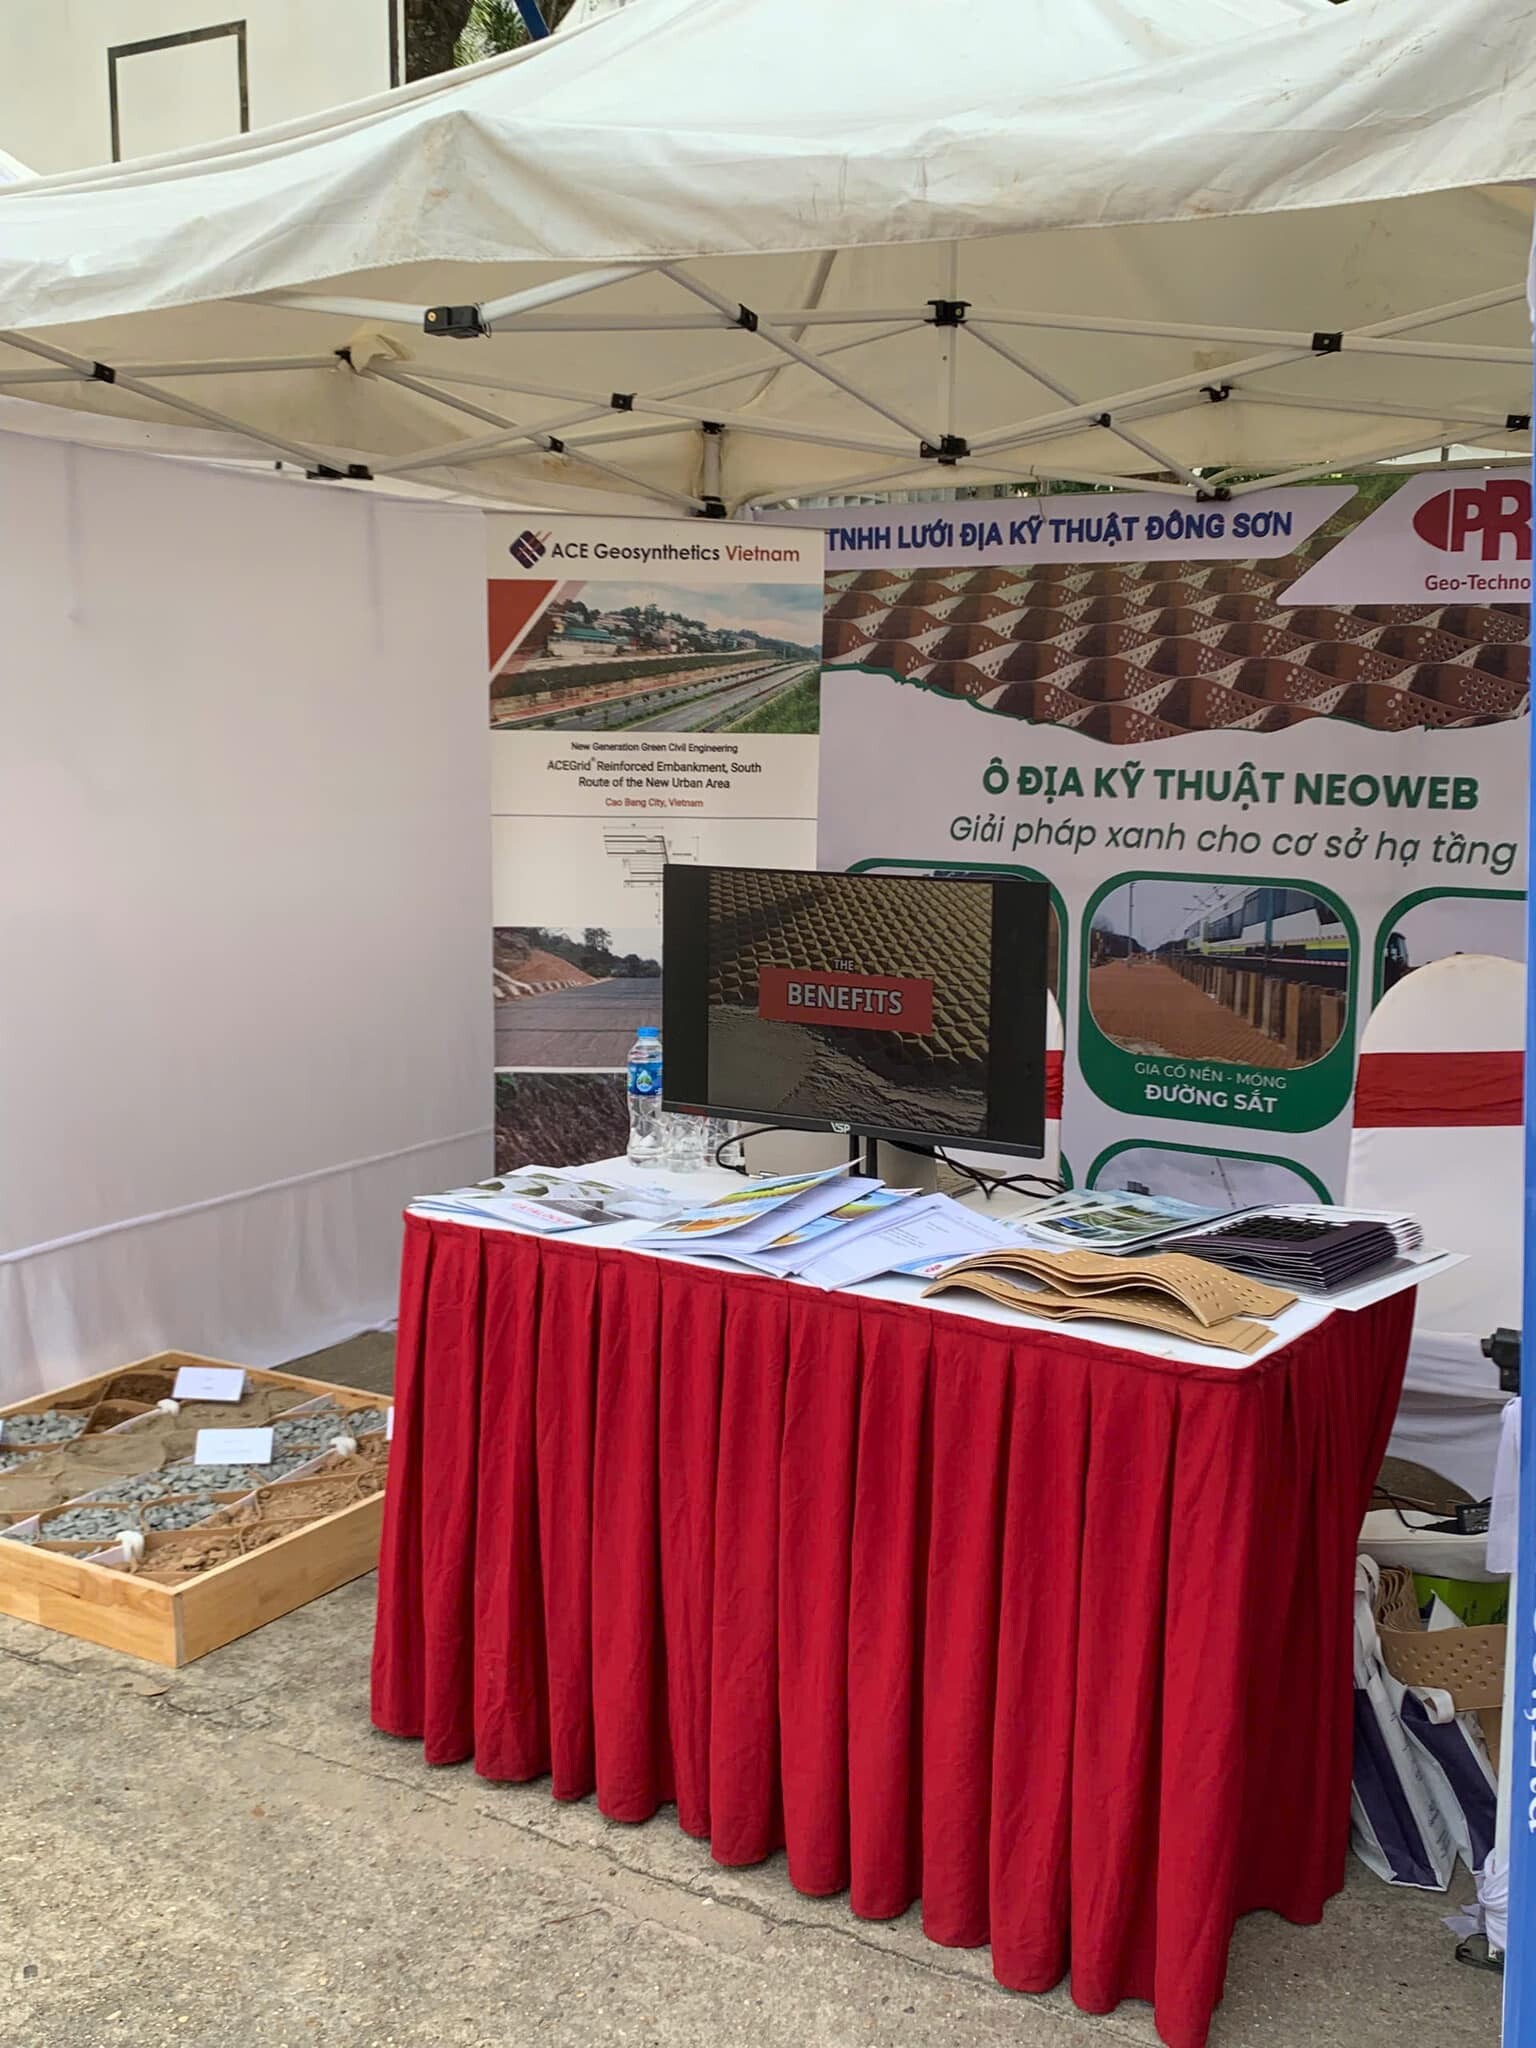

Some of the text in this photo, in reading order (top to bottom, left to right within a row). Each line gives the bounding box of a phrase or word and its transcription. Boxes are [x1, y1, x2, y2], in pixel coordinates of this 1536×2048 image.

[825, 509, 1293, 551] TNHH LƯỚI ĐỊA KỸ THUẬT ĐÔNG SƠN
[551, 543, 800, 563] ACE Geosynthetics Vietnam
[571, 742, 738, 754] New Generation Green Civil Engineering
[597, 760, 654, 772] Reinforced
[657, 761, 728, 774] Embankment,
[731, 762, 762, 774] South
[579, 777, 730, 789] Route of the New Urban Area
[982, 757, 1479, 811] Ô ĐỊA KỸ THUẬT NEOWEB
[605, 798, 704, 808] Cao Bang City, Vietnam
[950, 813, 1518, 875] Giải pháp xanh cho cơ sở hạ tầng
[834, 959, 854, 971] THE
[787, 982, 903, 1015] BENEFITS
[1134, 1062, 1161, 1076] GIA
[1144, 1084, 1278, 1113] ĐƯỜNG SẮT
